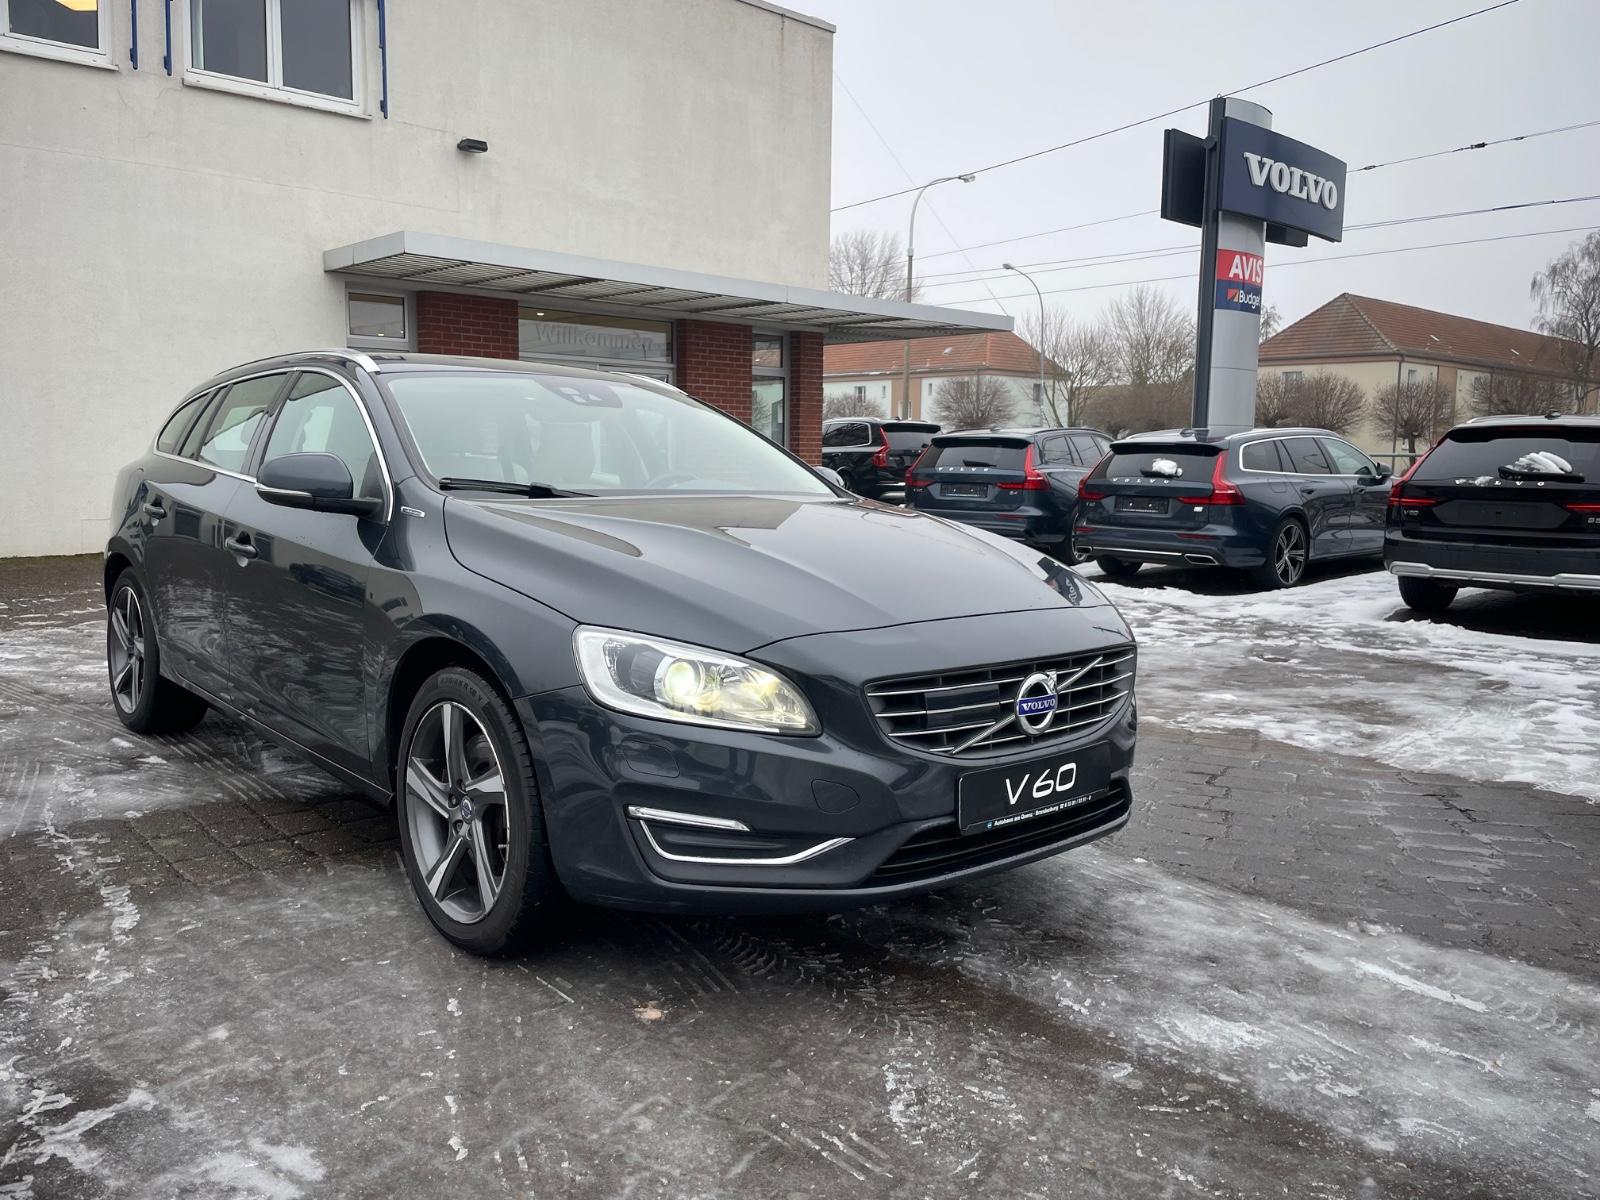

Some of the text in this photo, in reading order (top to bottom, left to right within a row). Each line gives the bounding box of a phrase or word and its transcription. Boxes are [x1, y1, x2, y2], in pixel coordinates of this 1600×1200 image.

[1243, 152, 1338, 210] VOLVO
[1228, 255, 1263, 284] AVIS
[1021, 698, 1056, 711] VOLVO
